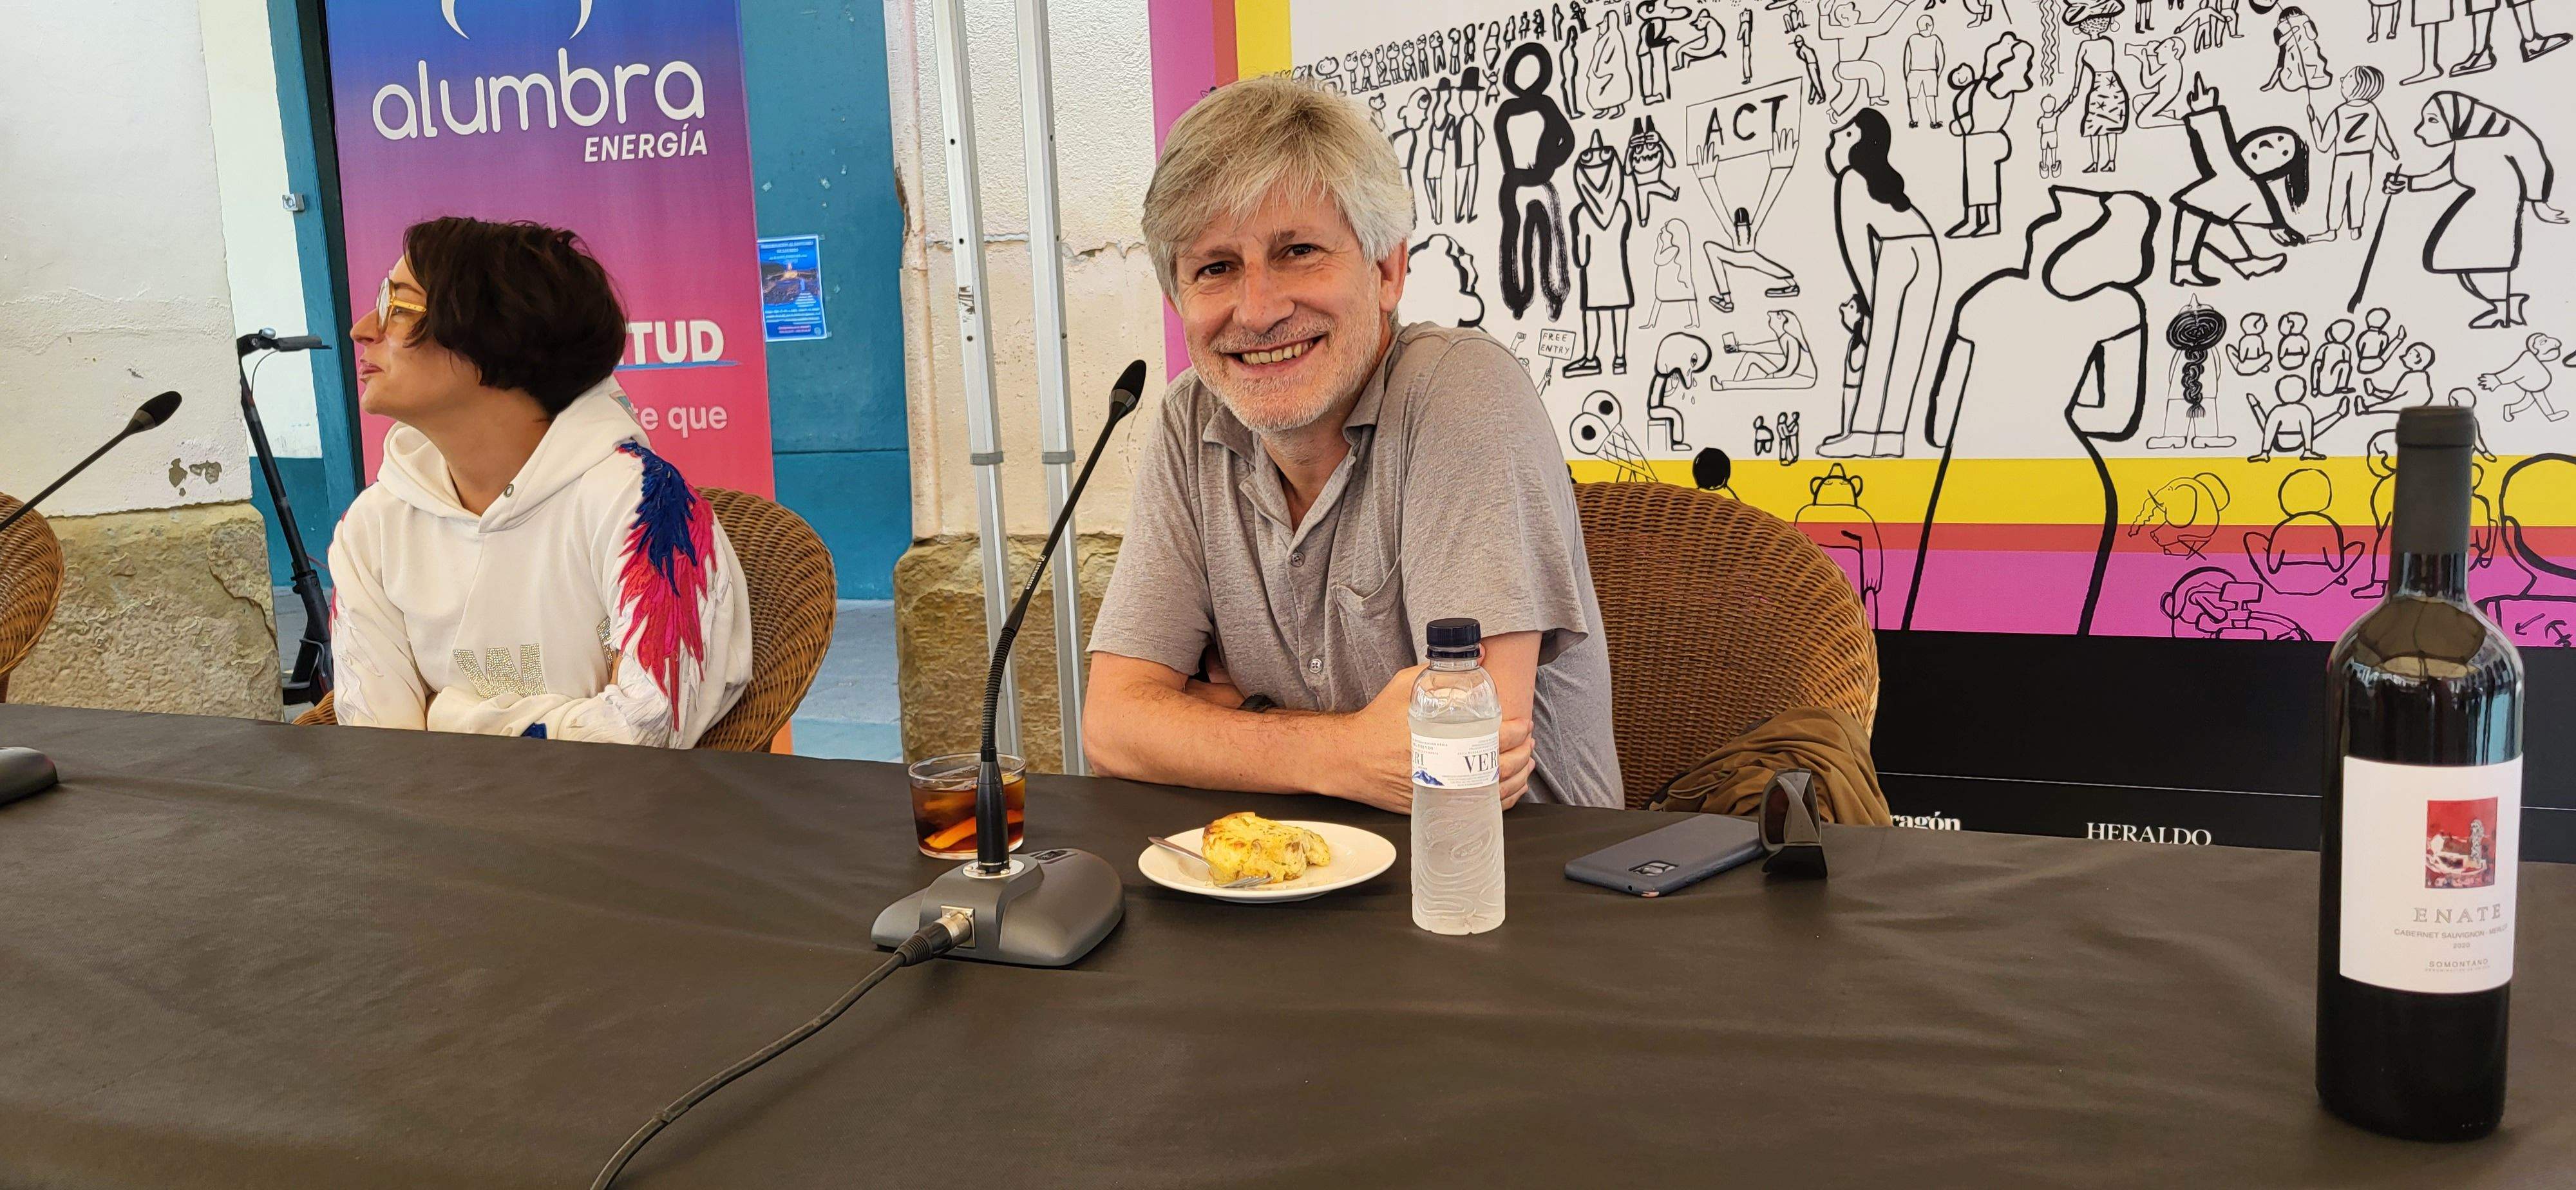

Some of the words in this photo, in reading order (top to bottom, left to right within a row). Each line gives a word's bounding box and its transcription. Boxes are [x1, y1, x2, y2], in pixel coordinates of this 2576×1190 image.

[372, 48, 705, 140] alumbra
[1705, 95, 1788, 146] ACT
[584, 123, 708, 162] ENERGÍA
[619, 320, 724, 364] TUD
[1542, 332, 1567, 342] FREE
[1540, 344, 1570, 355] ENTRY
[668, 406, 728, 439] que
[2086, 822, 2212, 845] HERALDO
[2413, 903, 2501, 923] ENATE
[2394, 929, 2439, 938] CABERNET
[2441, 930, 2485, 939] SAUVIGNON
[2429, 959, 2488, 968] SOMONTANO
